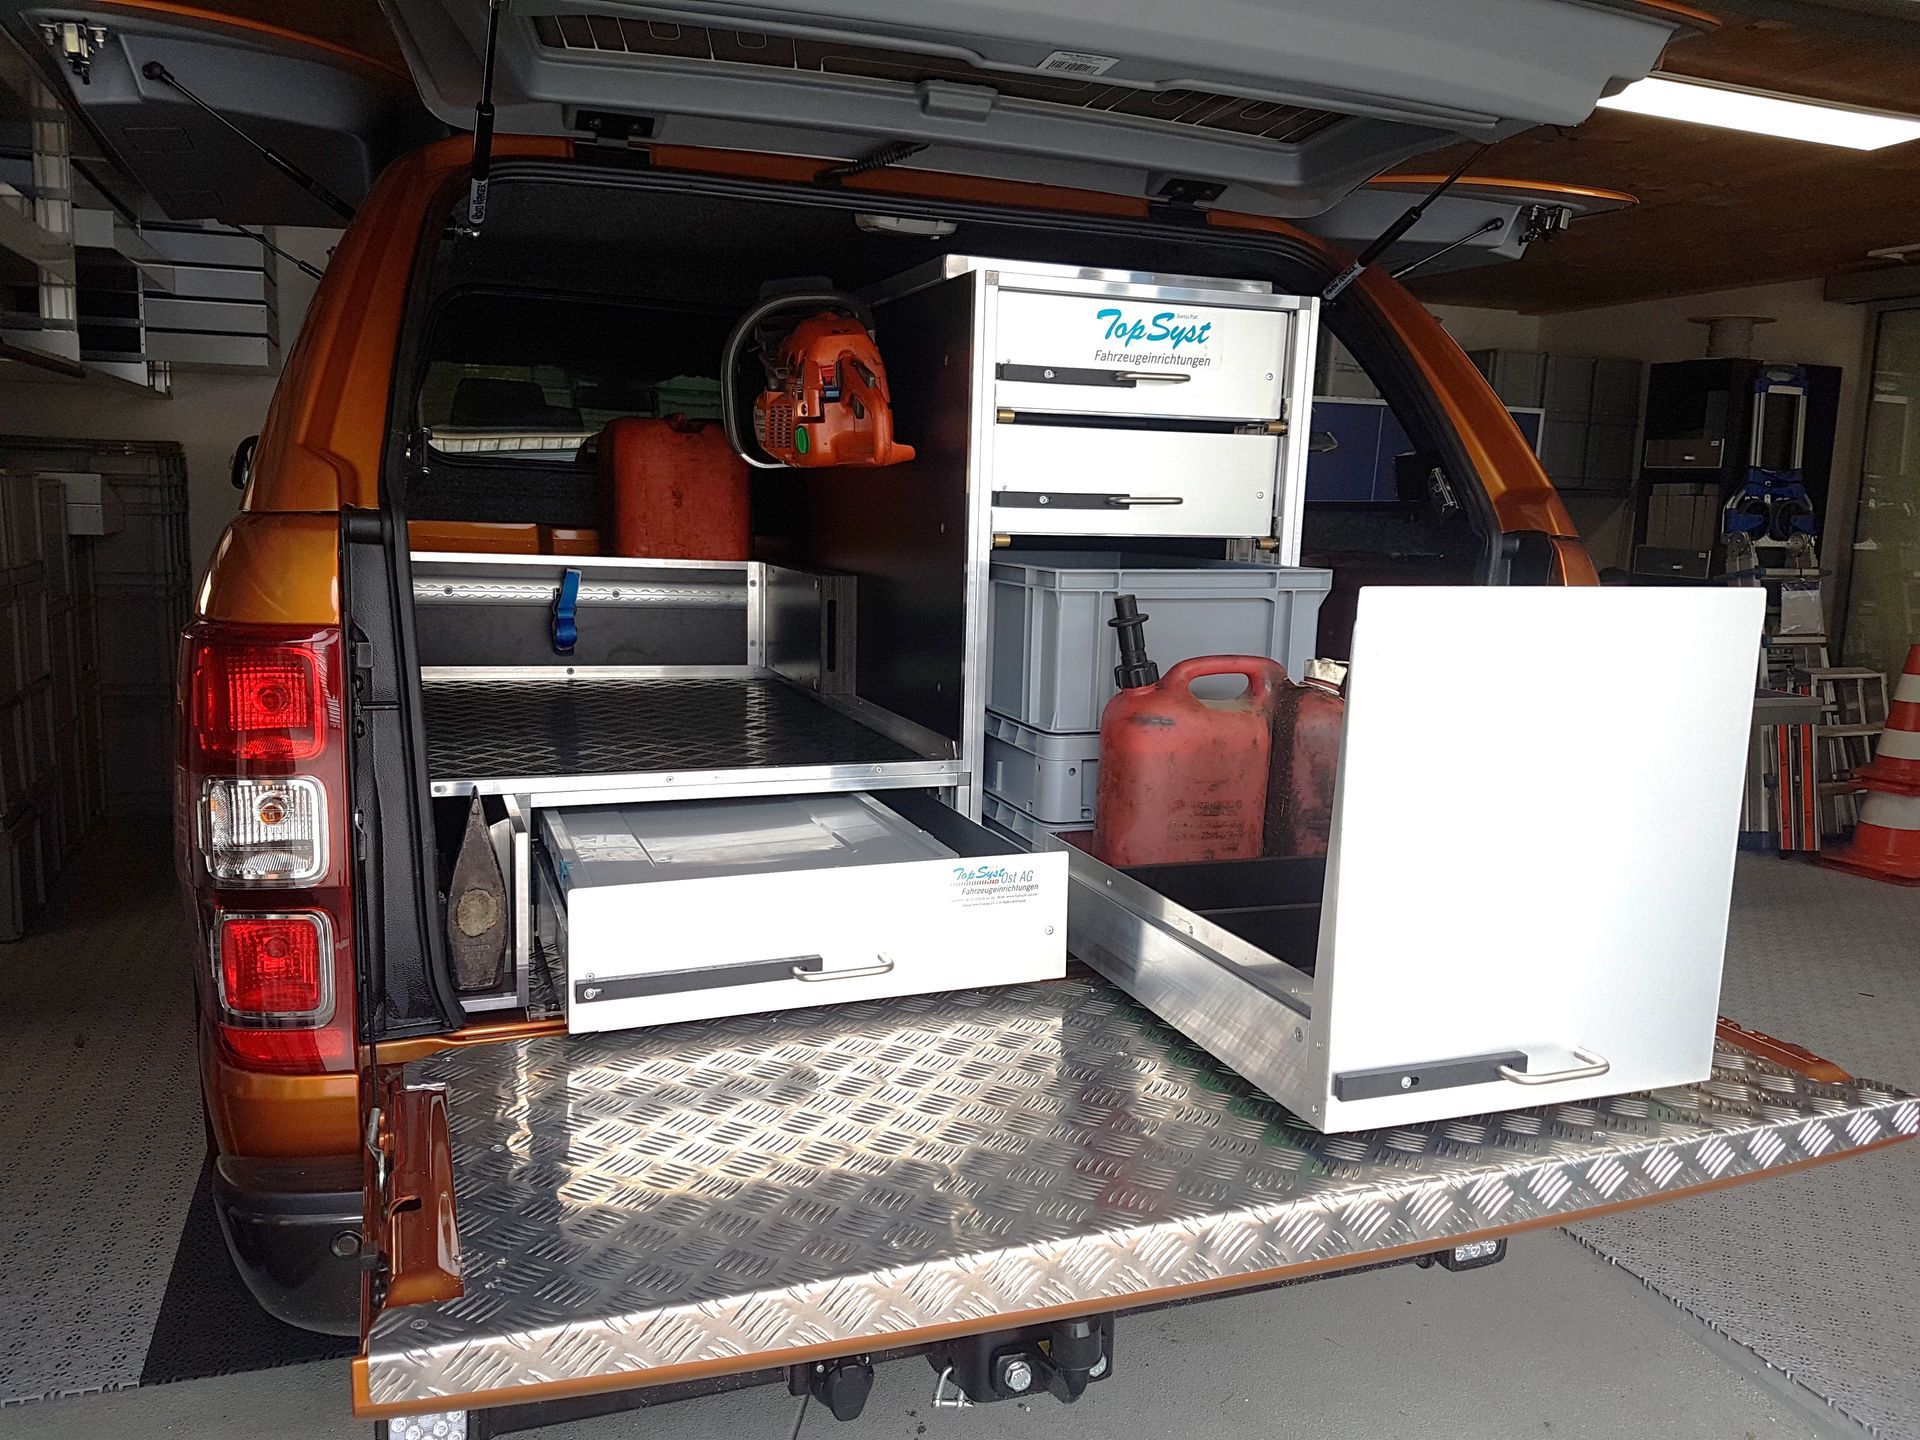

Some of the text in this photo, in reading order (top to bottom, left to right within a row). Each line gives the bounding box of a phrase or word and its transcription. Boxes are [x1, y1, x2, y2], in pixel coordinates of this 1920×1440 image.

[1094, 349, 1211, 368] Fahrzeugeinrichtungen
[1001, 871, 1017, 884] Ost
[1019, 869, 1034, 882] AG
[961, 883, 1039, 895] Fahrzeugeinrichtungen
